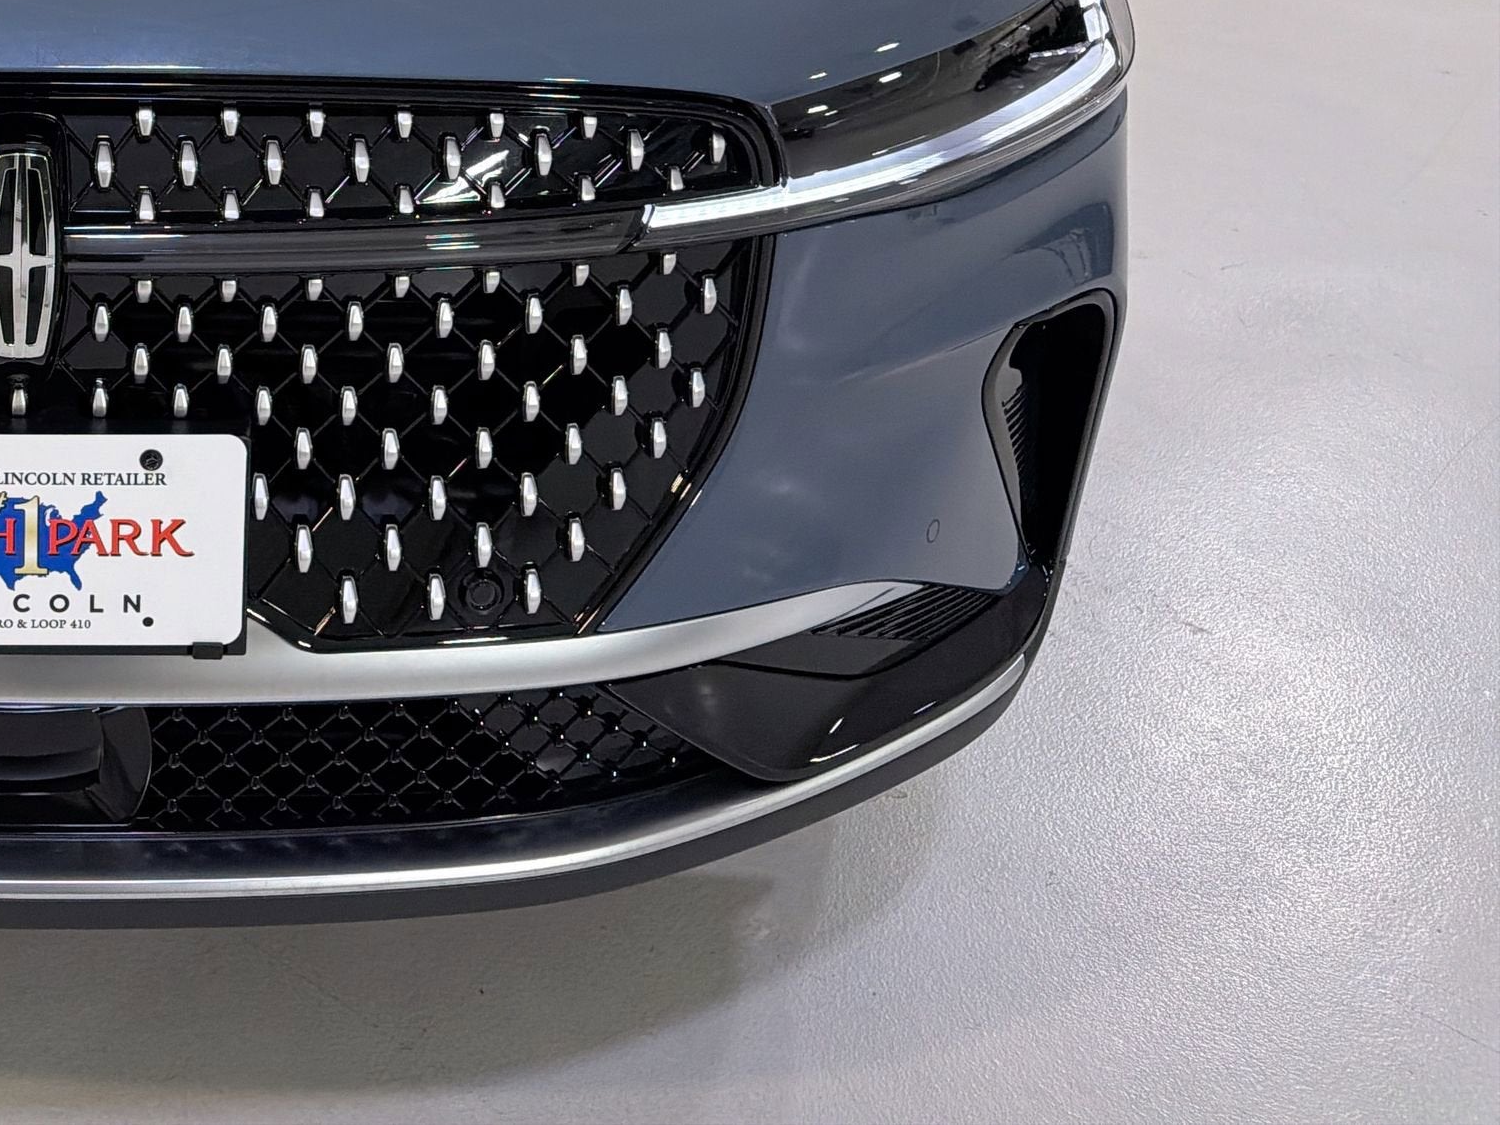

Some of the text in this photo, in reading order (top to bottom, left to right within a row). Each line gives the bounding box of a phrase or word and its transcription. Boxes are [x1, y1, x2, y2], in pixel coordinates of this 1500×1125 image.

[80, 472, 167, 486] RETAILER
[47, 518, 195, 557] PARK
[17, 619, 28, 629] &
[31, 619, 67, 629] LOOP
[70, 619, 91, 629] 410
